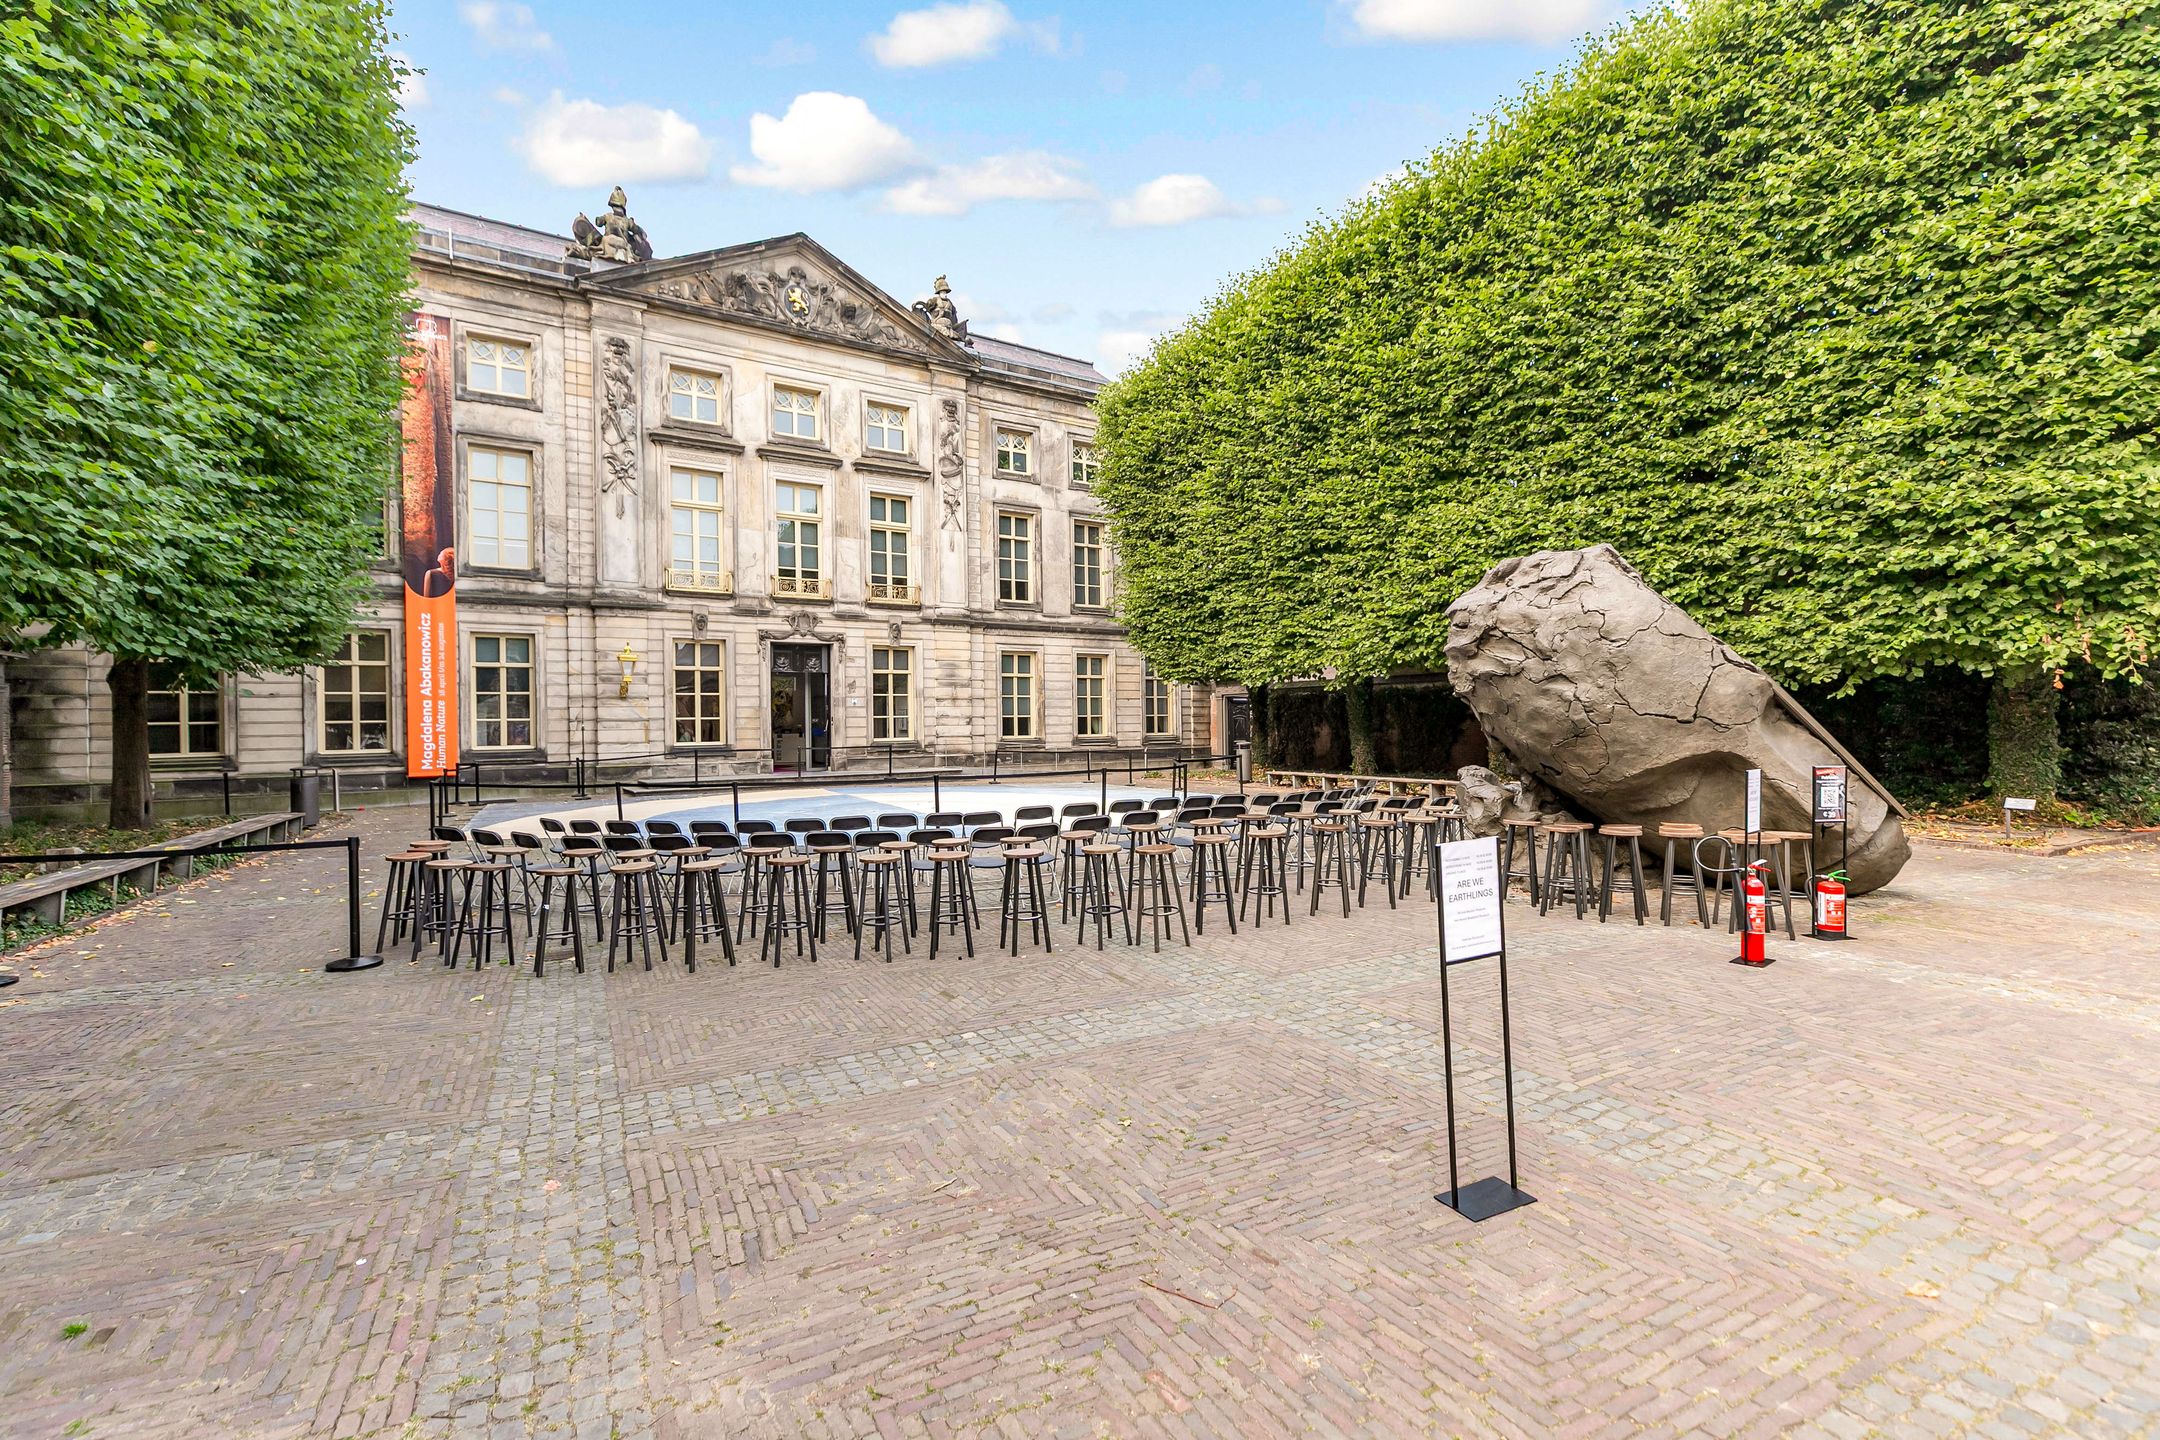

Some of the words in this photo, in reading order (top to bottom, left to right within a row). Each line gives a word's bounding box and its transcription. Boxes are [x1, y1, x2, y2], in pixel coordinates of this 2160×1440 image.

[418, 613, 432, 697] Abakanowicz
[438, 674, 446, 688] april
[436, 700, 446, 733] Nature
[420, 699, 436, 770] Magdalena
[436, 734, 447, 769] Human
[1448, 888, 1494, 903] EARTHLINGS
[1457, 879, 1471, 888] ARE
[1472, 877, 1484, 886] WE
